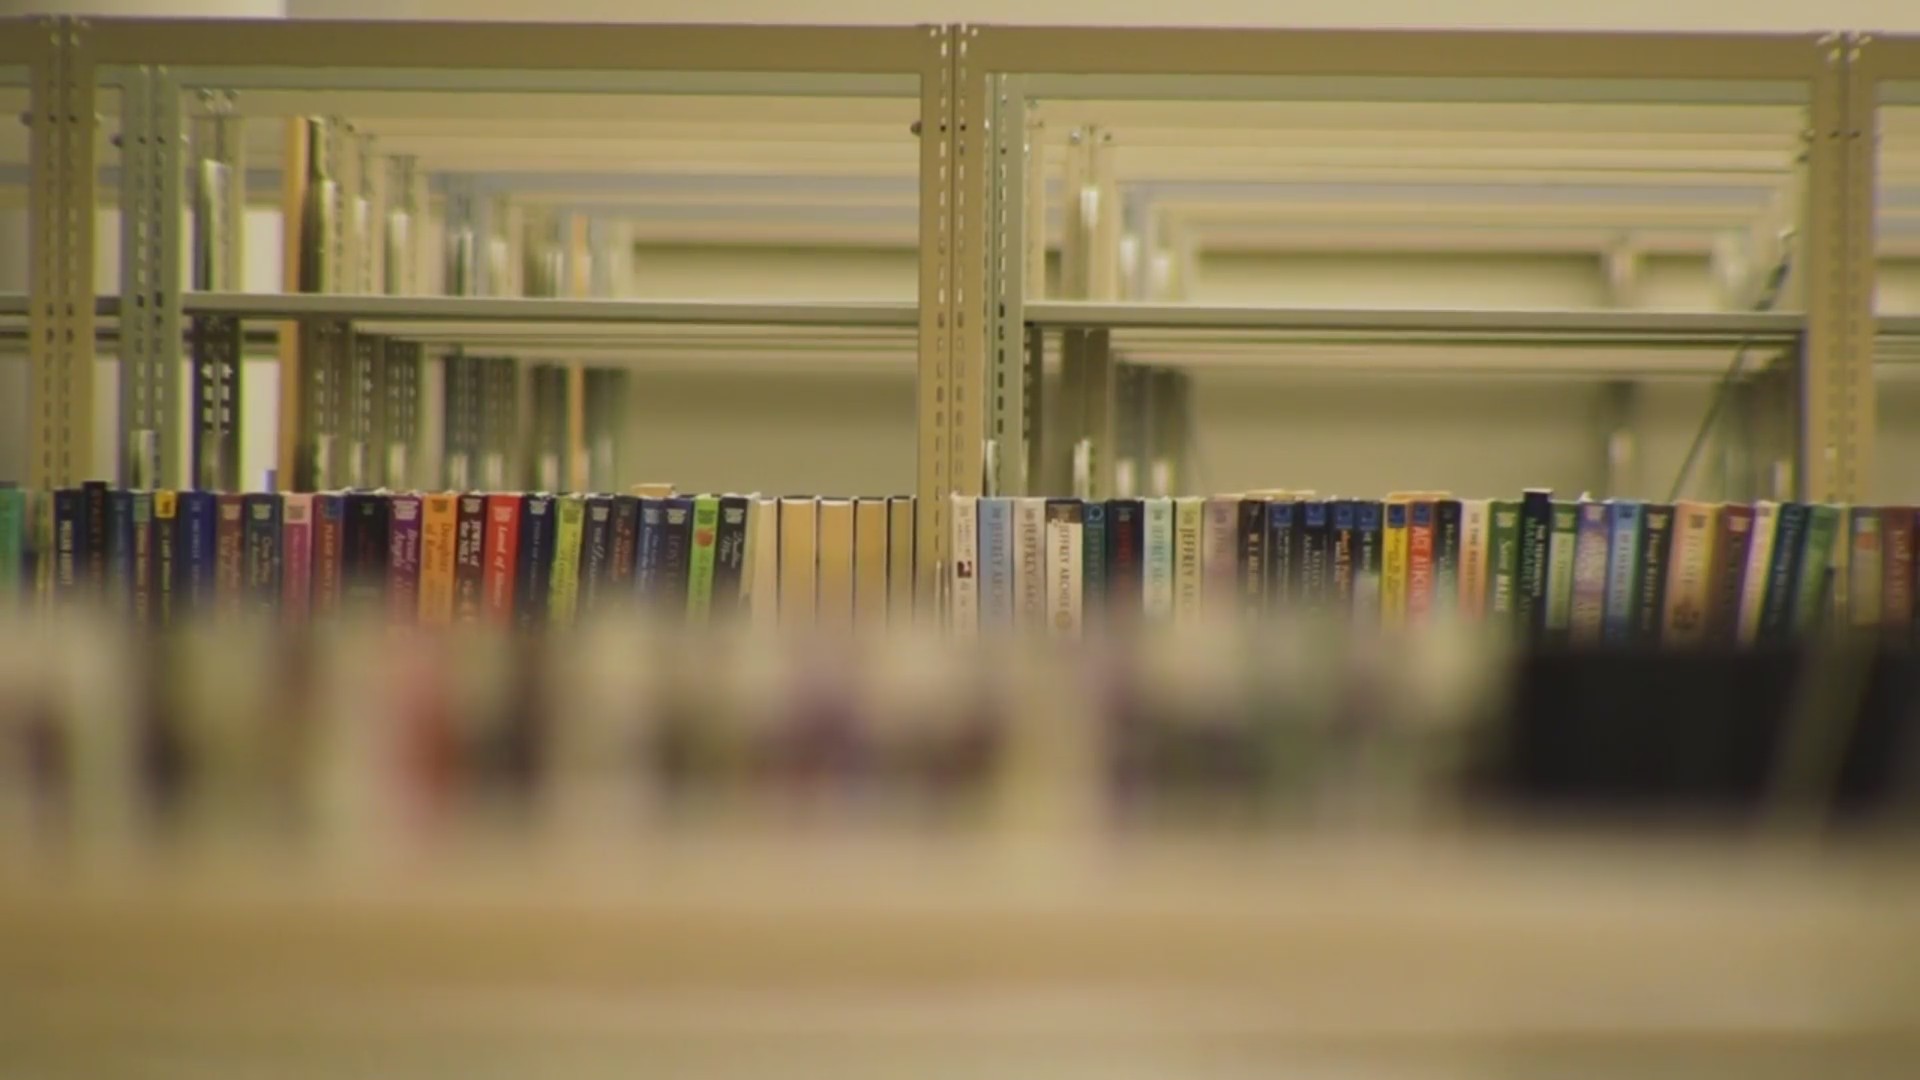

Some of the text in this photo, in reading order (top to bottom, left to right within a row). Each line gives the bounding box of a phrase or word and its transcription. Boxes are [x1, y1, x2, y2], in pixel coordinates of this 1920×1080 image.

[391, 531, 405, 567] Angels
[471, 520, 482, 553] JEWEL
[988, 522, 1004, 566] JEFFREY
[1021, 523, 1037, 577] JEFFREY
[1180, 528, 1196, 576] JEFFREY
[1521, 517, 1536, 590] MARGARET
[1059, 525, 1071, 609] JEFFREY ARCHER
